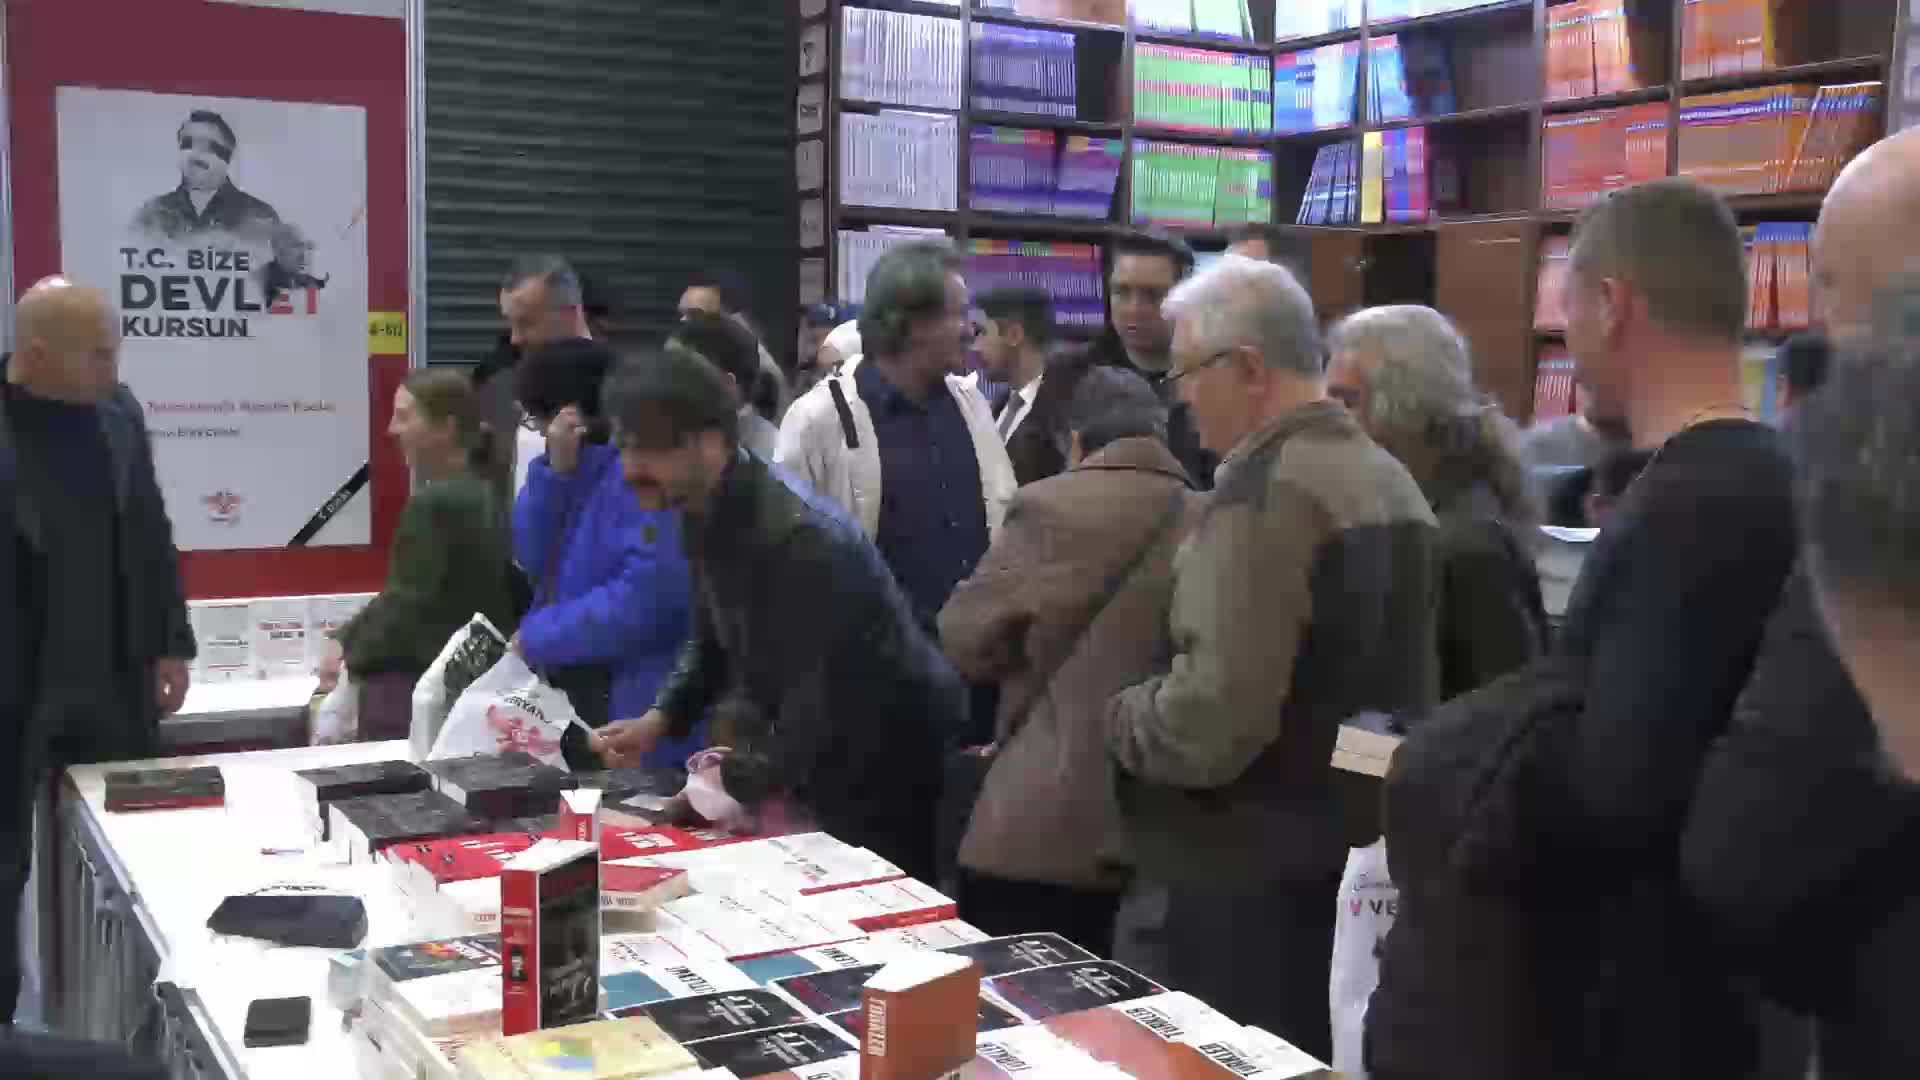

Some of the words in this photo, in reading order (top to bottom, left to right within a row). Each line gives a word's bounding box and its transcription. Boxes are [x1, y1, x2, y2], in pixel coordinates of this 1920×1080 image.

[120, 247, 174, 269] T.C.
[187, 246, 249, 271] BİZE
[121, 315, 249, 337] KURSUN
